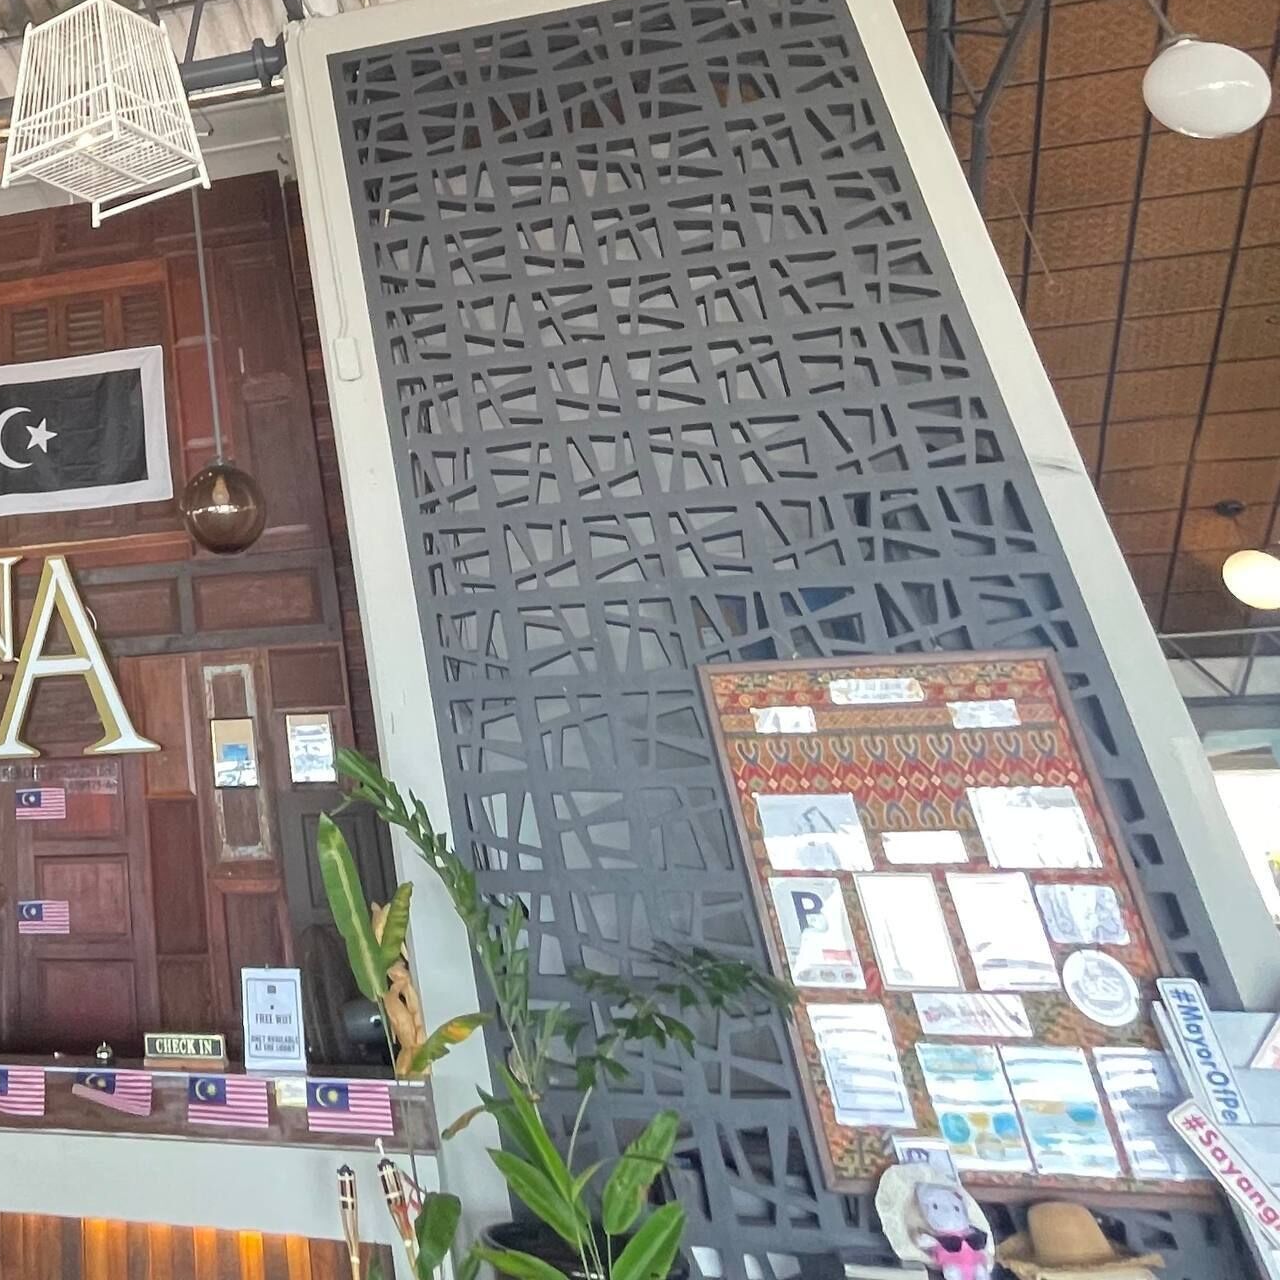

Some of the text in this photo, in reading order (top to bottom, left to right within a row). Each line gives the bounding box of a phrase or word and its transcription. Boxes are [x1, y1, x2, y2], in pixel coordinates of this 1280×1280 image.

[155, 1038, 213, 1055] CHECK IN
[1182, 1114, 1280, 1232] #Sayang
